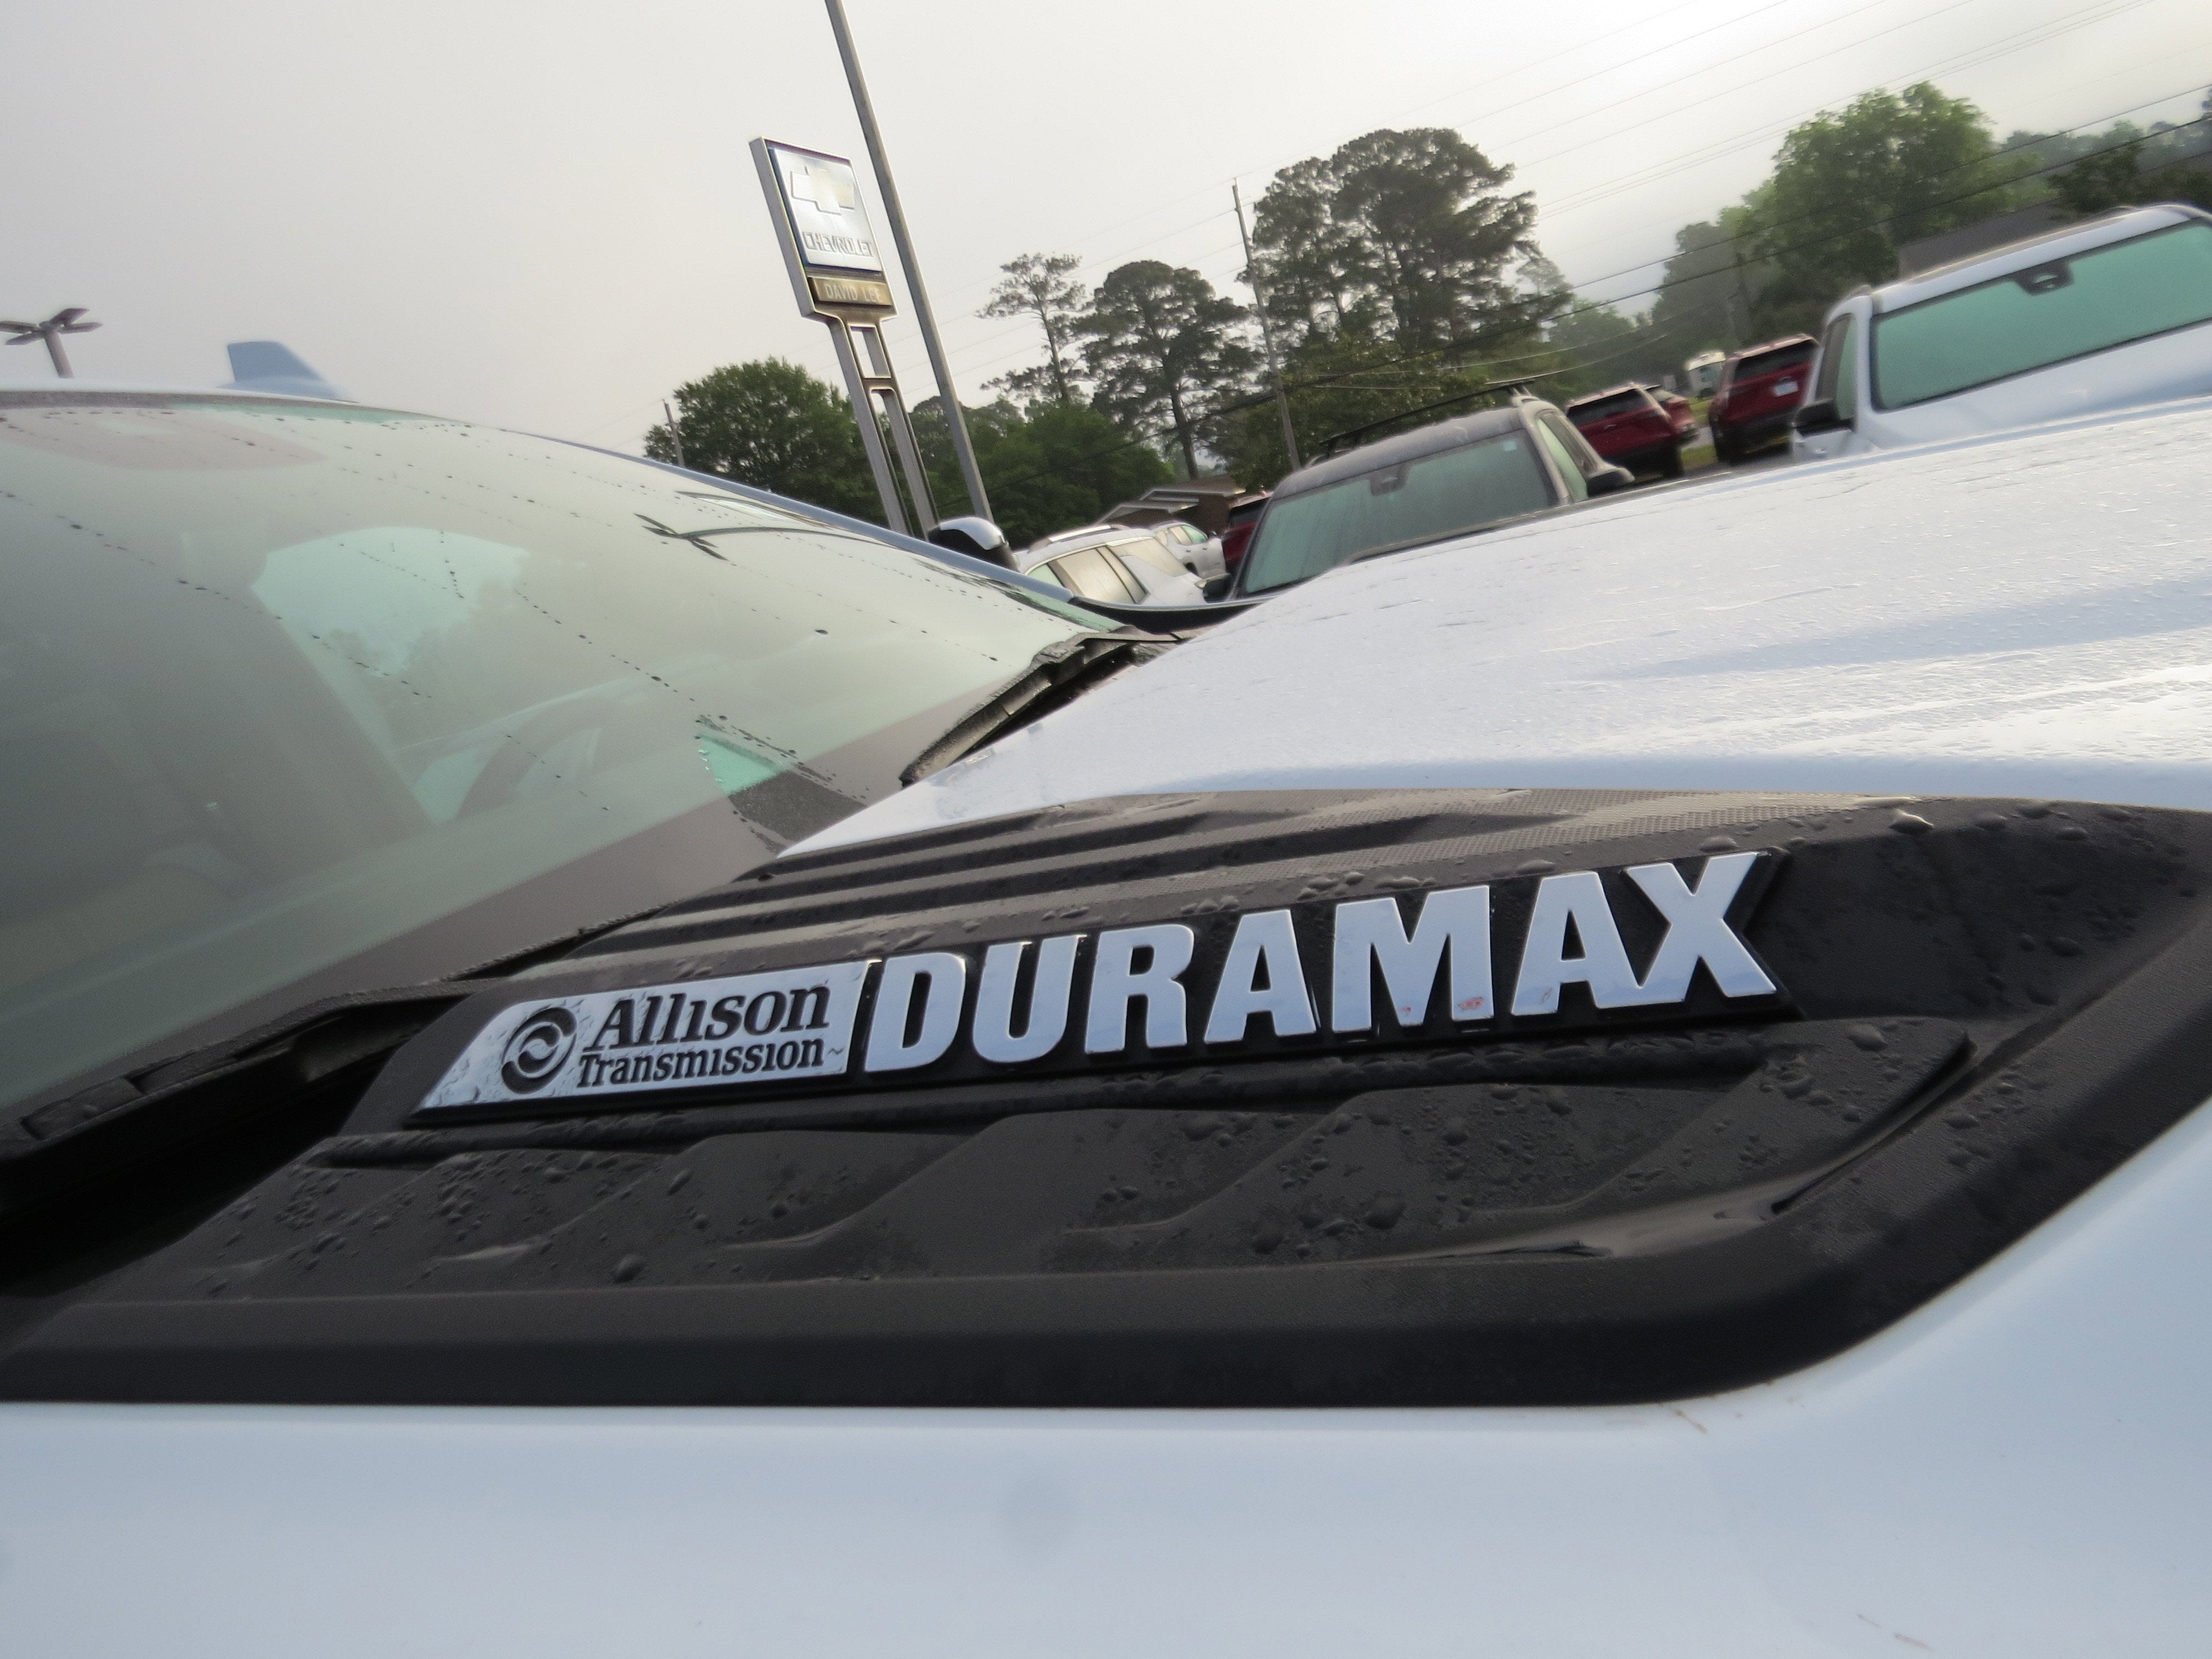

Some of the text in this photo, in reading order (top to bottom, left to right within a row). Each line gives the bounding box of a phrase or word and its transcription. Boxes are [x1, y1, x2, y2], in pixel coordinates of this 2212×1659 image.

[803, 231, 873, 257] CHEVROLET
[825, 283, 858, 300] DAVID
[864, 852, 1777, 1074] DURAMAX
[583, 984, 831, 1052] Allison
[577, 1039, 824, 1088] Transmission
